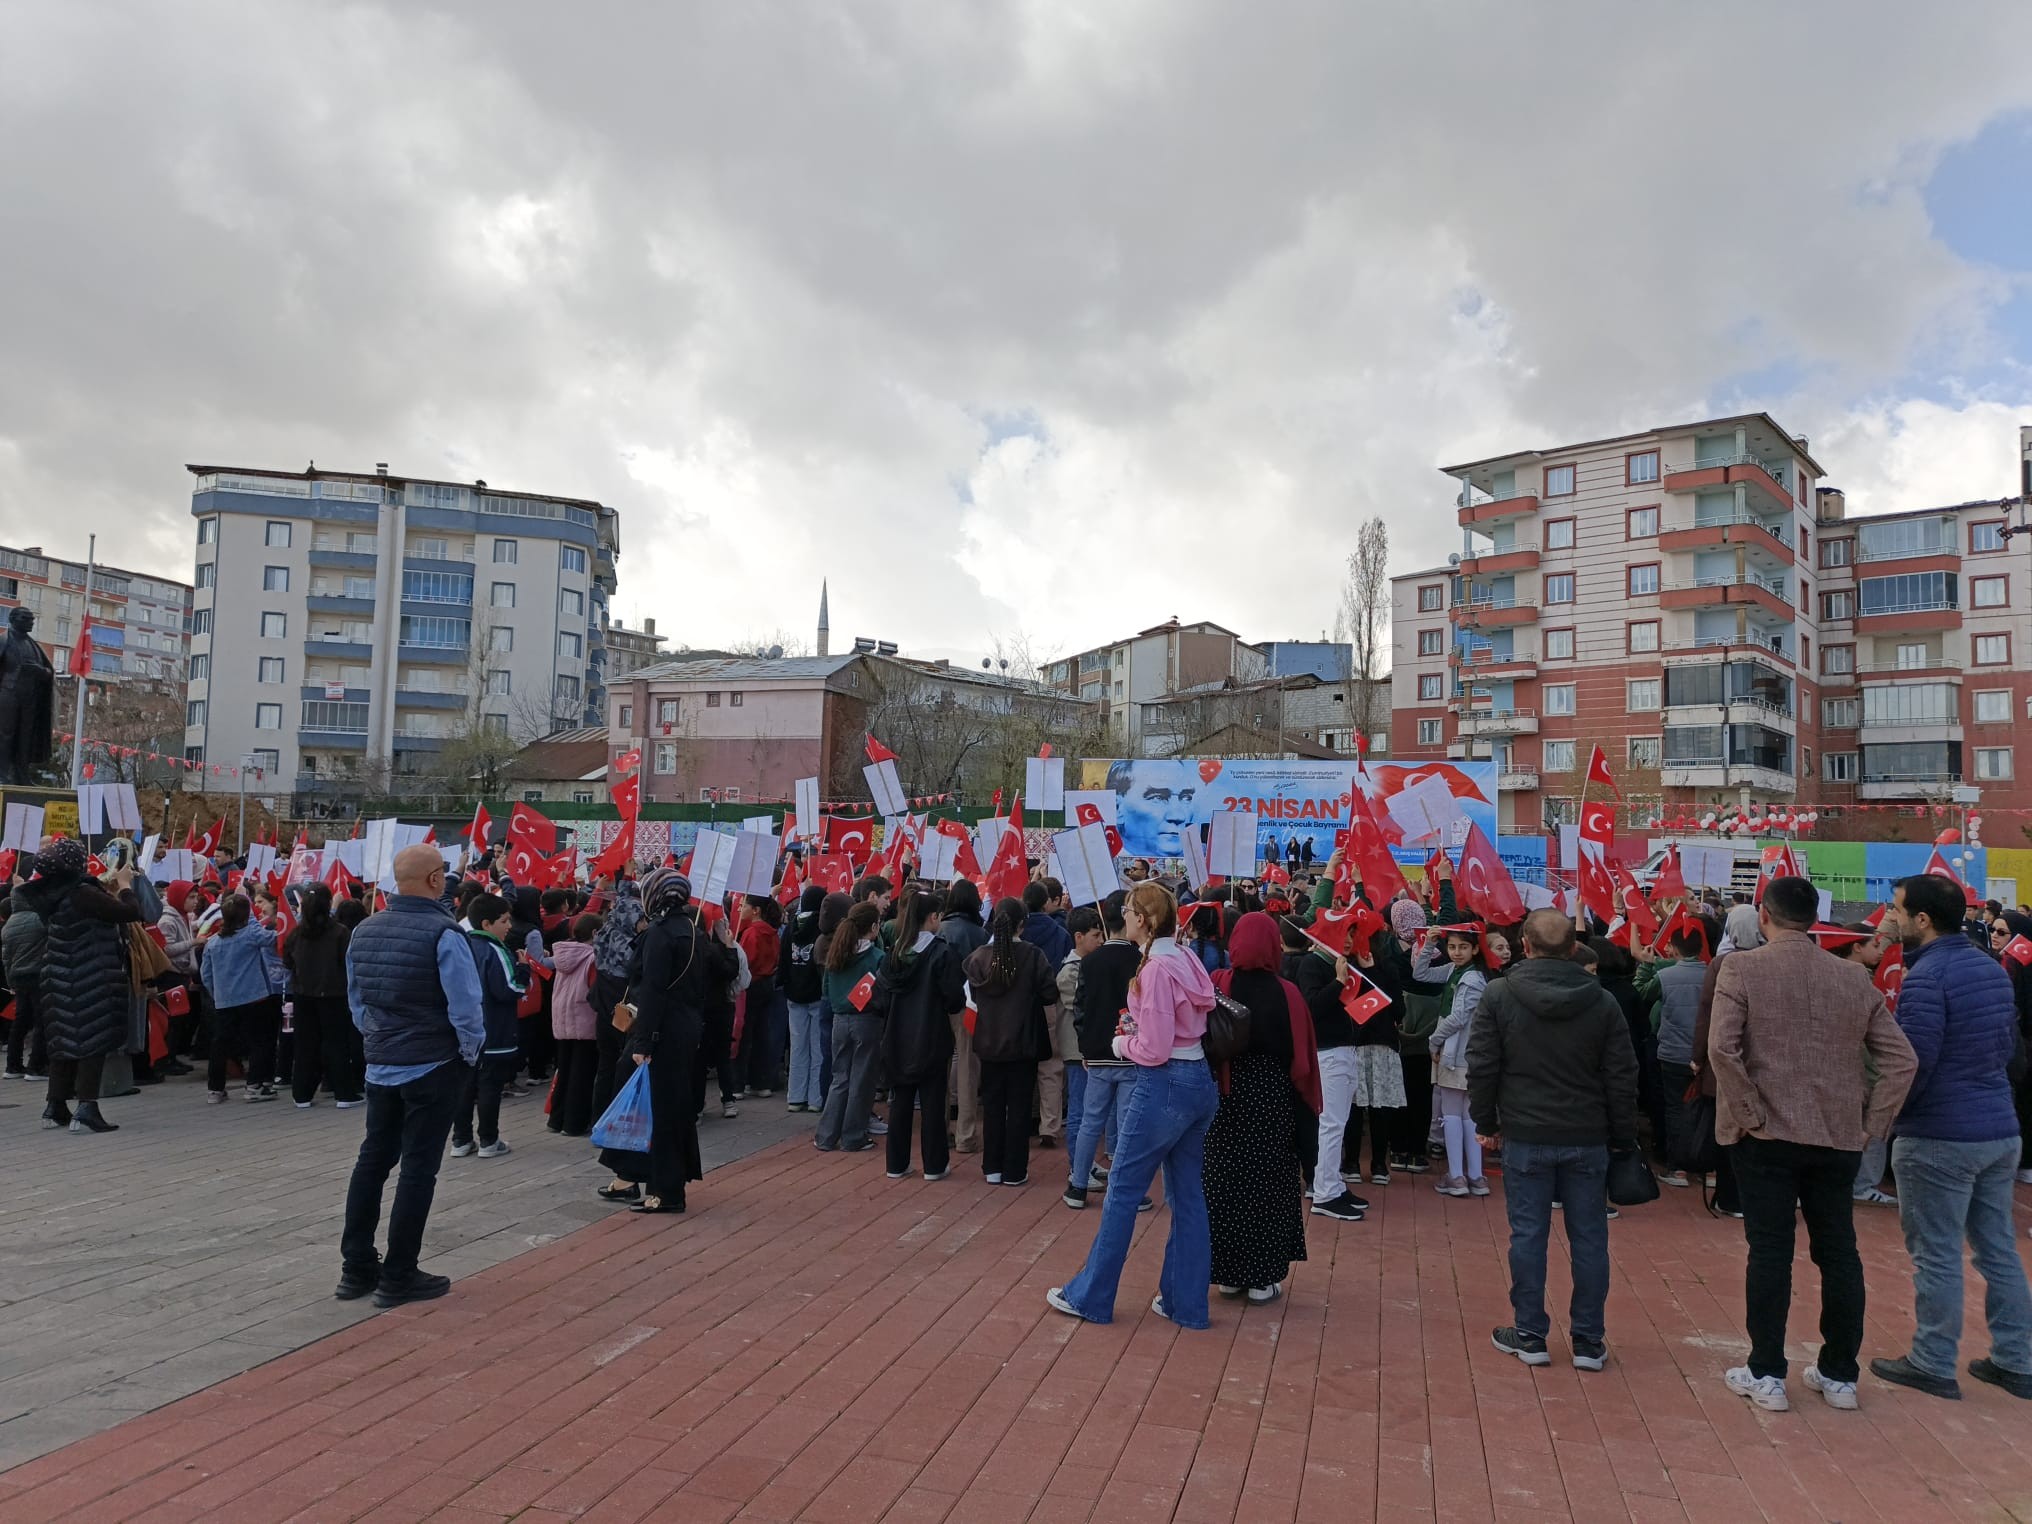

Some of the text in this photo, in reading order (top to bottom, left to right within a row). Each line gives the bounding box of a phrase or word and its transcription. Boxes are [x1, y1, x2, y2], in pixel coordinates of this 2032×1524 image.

[1257, 793, 1339, 819] NİSAN
[1288, 821, 1312, 829] Çocuk
[1313, 822, 1347, 830] Bayramı
